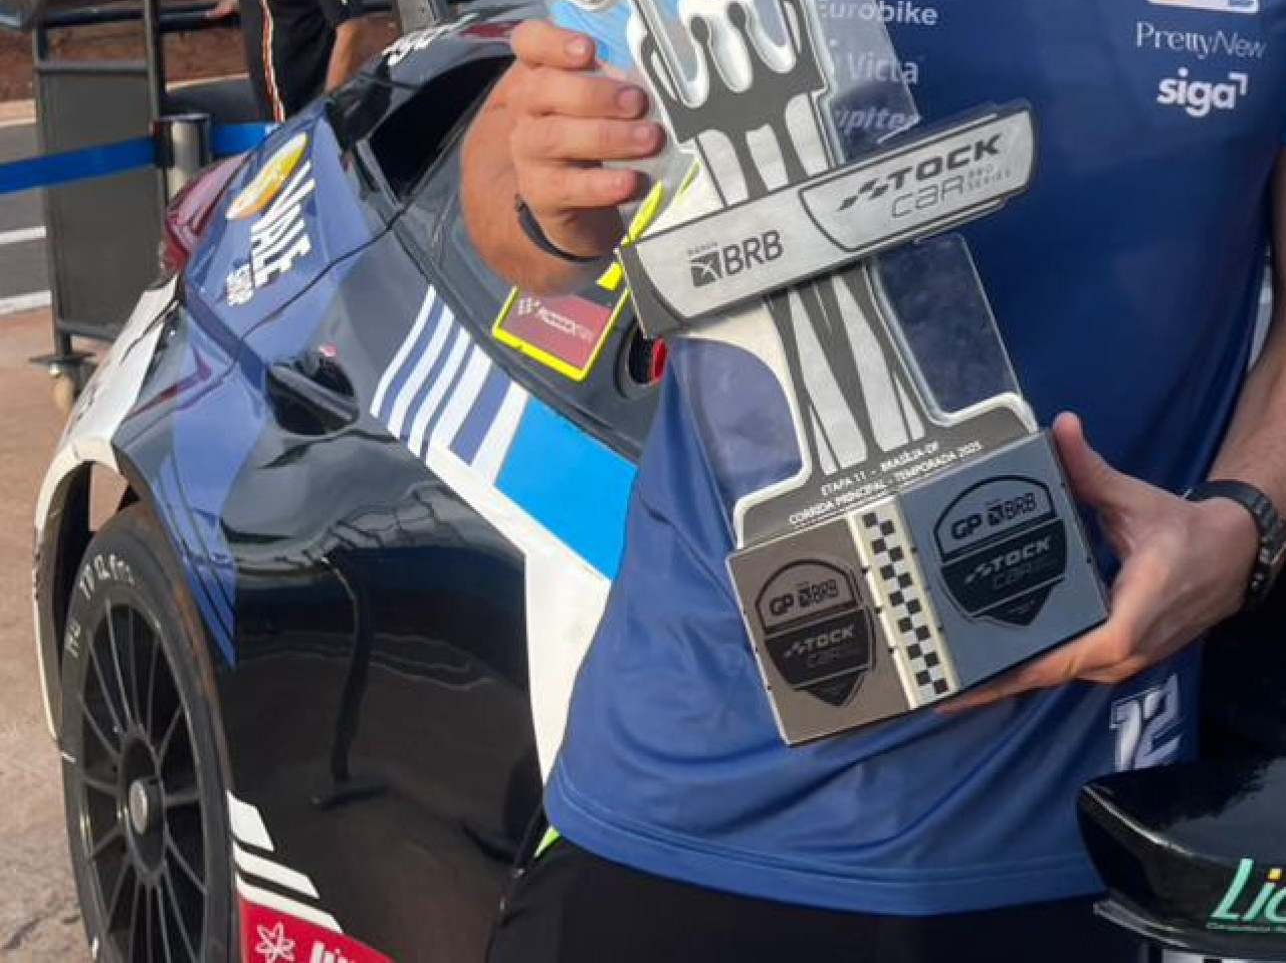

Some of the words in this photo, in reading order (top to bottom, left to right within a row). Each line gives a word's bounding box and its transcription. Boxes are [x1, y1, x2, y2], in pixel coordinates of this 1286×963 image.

[1136, 20, 1267, 59] PrettyNew
[1157, 66, 1237, 118] siga
[722, 230, 784, 276] BRB
[894, 450, 957, 481] TEMPORADA
[951, 514, 982, 540] GP
[769, 593, 795, 616] GP
